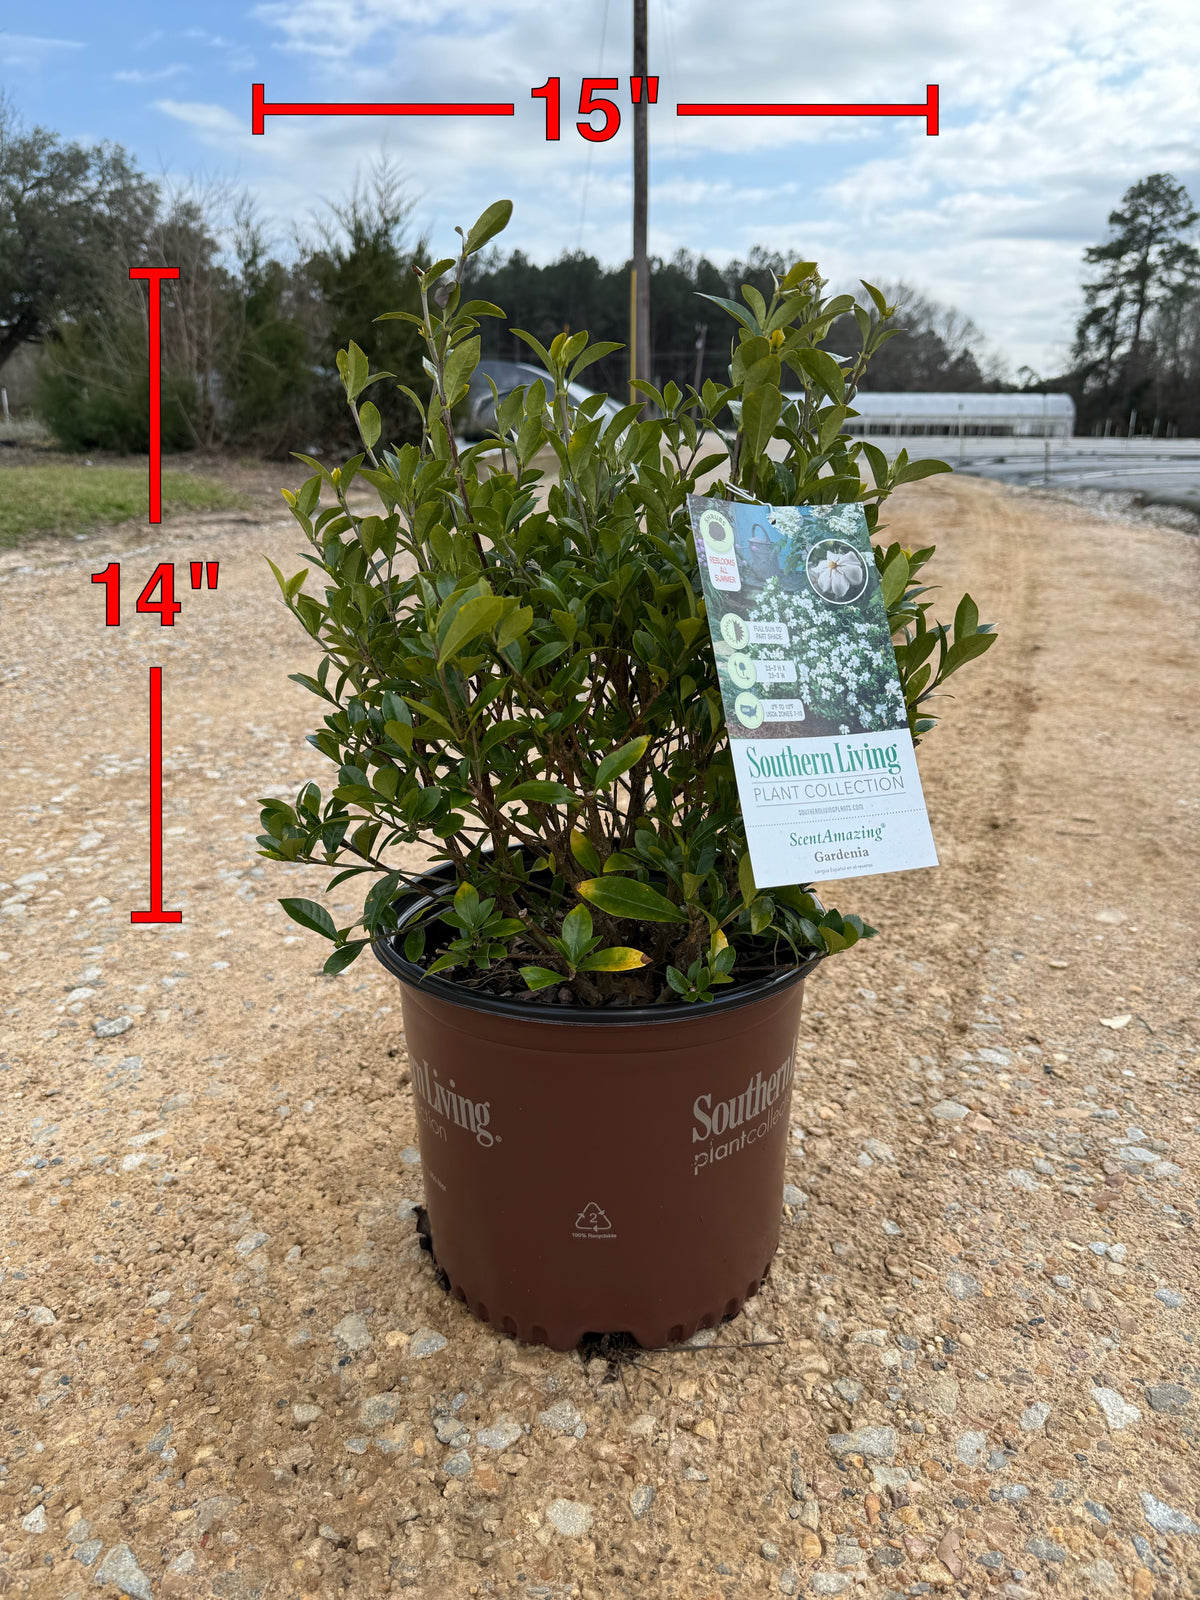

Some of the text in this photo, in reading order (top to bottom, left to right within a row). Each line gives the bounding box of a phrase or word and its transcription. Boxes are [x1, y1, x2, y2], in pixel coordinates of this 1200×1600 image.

[714, 574, 737, 584] SUMMER
[746, 742, 902, 779] Southern Living
[754, 776, 905, 802] PLANT COLLECTION
[814, 847, 869, 863] Gardenia
[692, 1056, 791, 1143] Southern
[589, 1212, 598, 1223] 2
